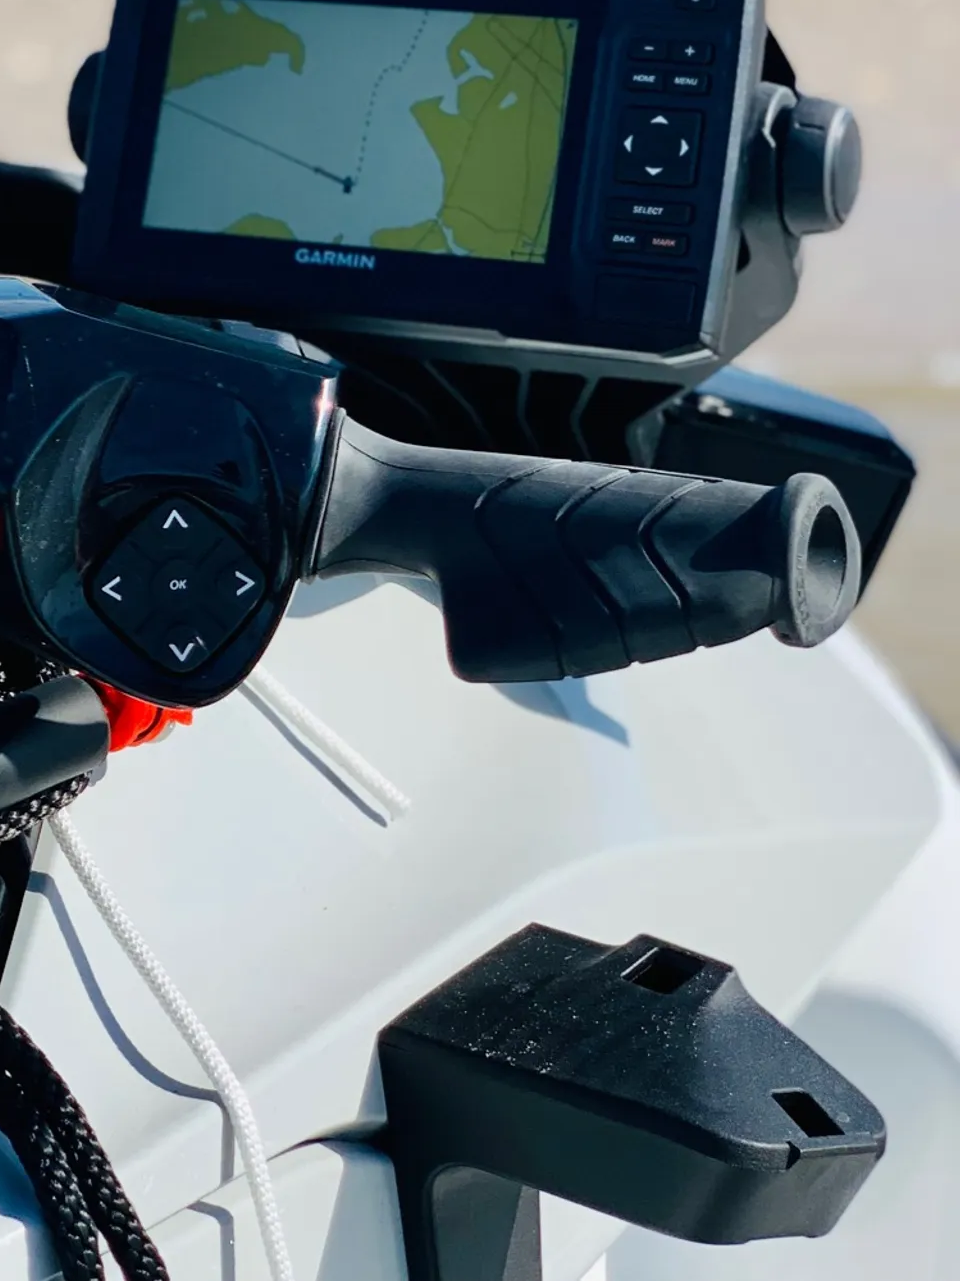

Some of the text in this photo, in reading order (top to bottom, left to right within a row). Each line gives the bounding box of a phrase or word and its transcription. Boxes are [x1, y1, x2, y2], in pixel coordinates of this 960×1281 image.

[632, 73, 656, 83] HOME
[673, 75, 699, 86] MENU
[632, 205, 664, 216] SELECT
[612, 233, 637, 244] BACK
[651, 237, 677, 248] MARK
[294, 247, 376, 270] GARMIN
[169, 579, 189, 591] OK
